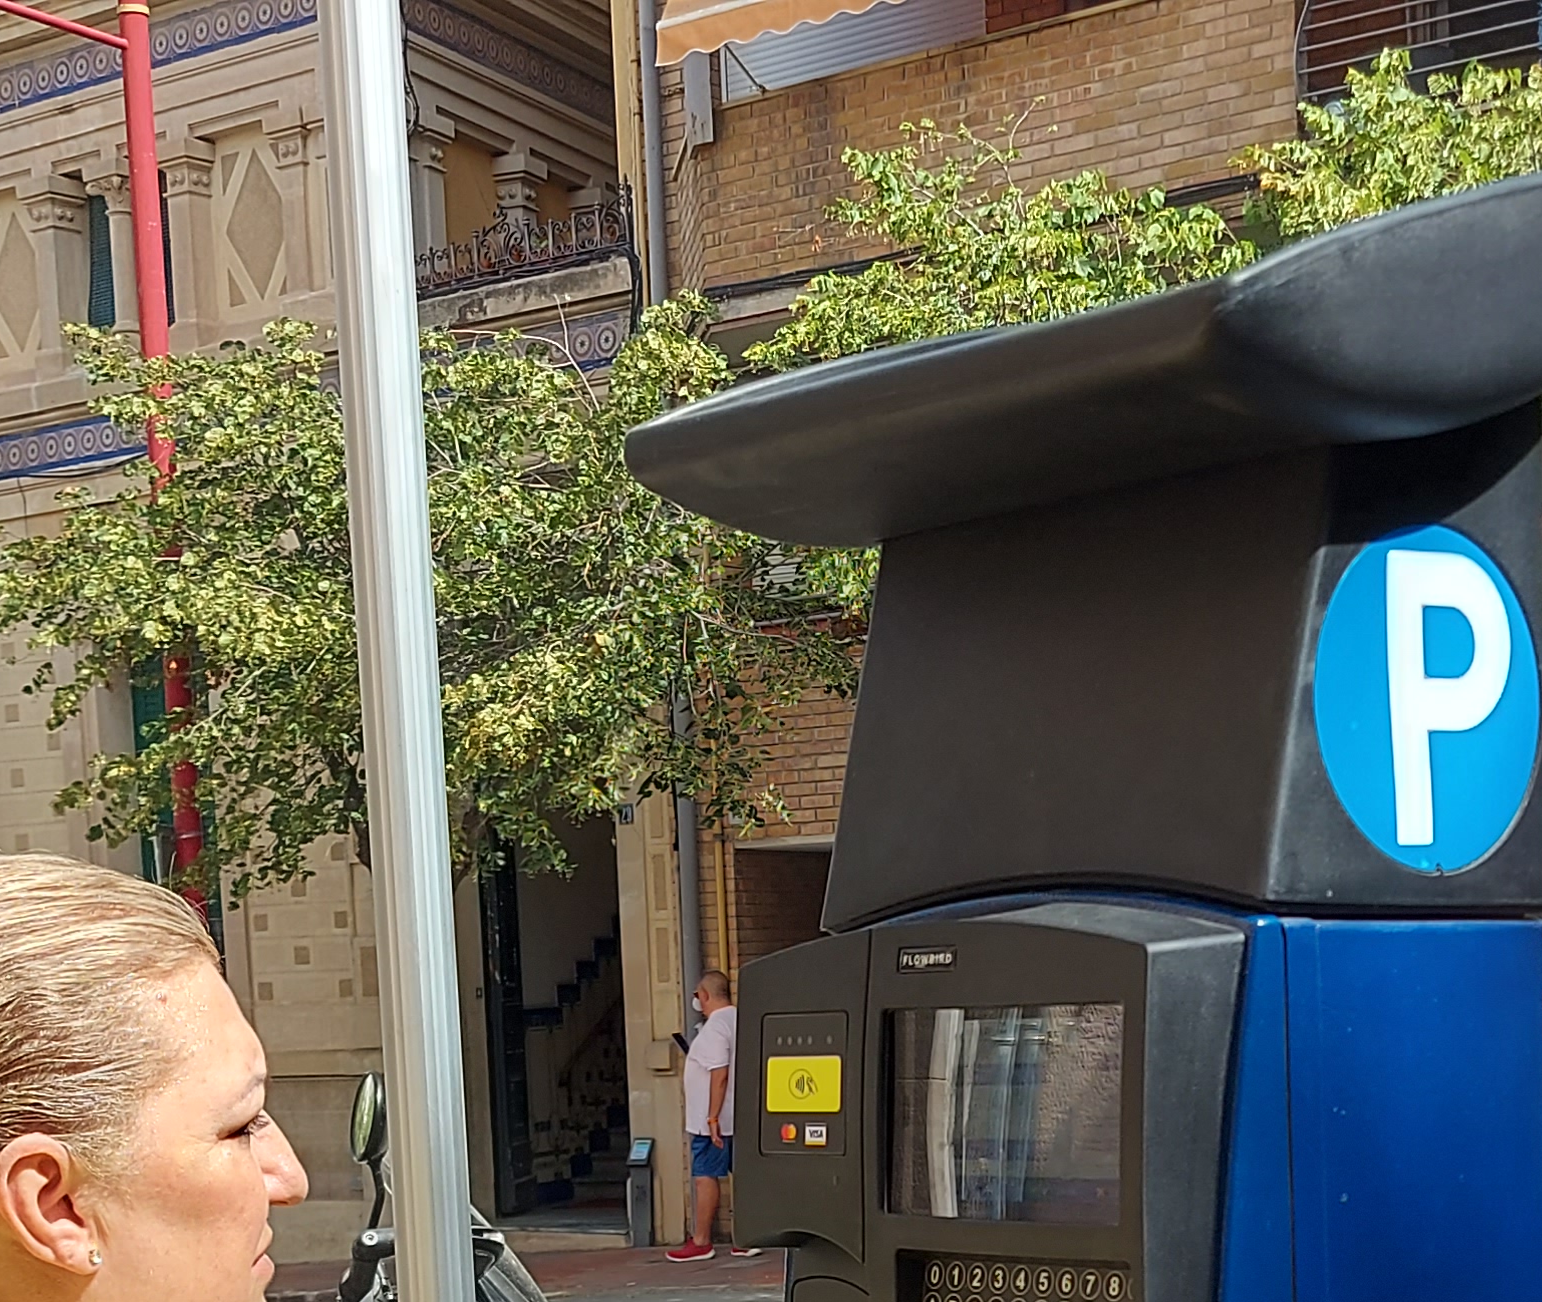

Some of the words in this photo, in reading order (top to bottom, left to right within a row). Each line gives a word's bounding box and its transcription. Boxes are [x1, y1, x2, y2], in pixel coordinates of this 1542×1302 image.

[1385, 549, 1511, 846] P
[930, 1265, 940, 1284] 0
[971, 1268, 982, 1287] 2
[993, 1269, 1004, 1289] 3
[1015, 1269, 1026, 1290] 4
[1038, 1271, 1049, 1291] 5
[1061, 1273, 1072, 1293] 6
[1085, 1275, 1096, 1295] 7
[1108, 1276, 1120, 1297] 8
